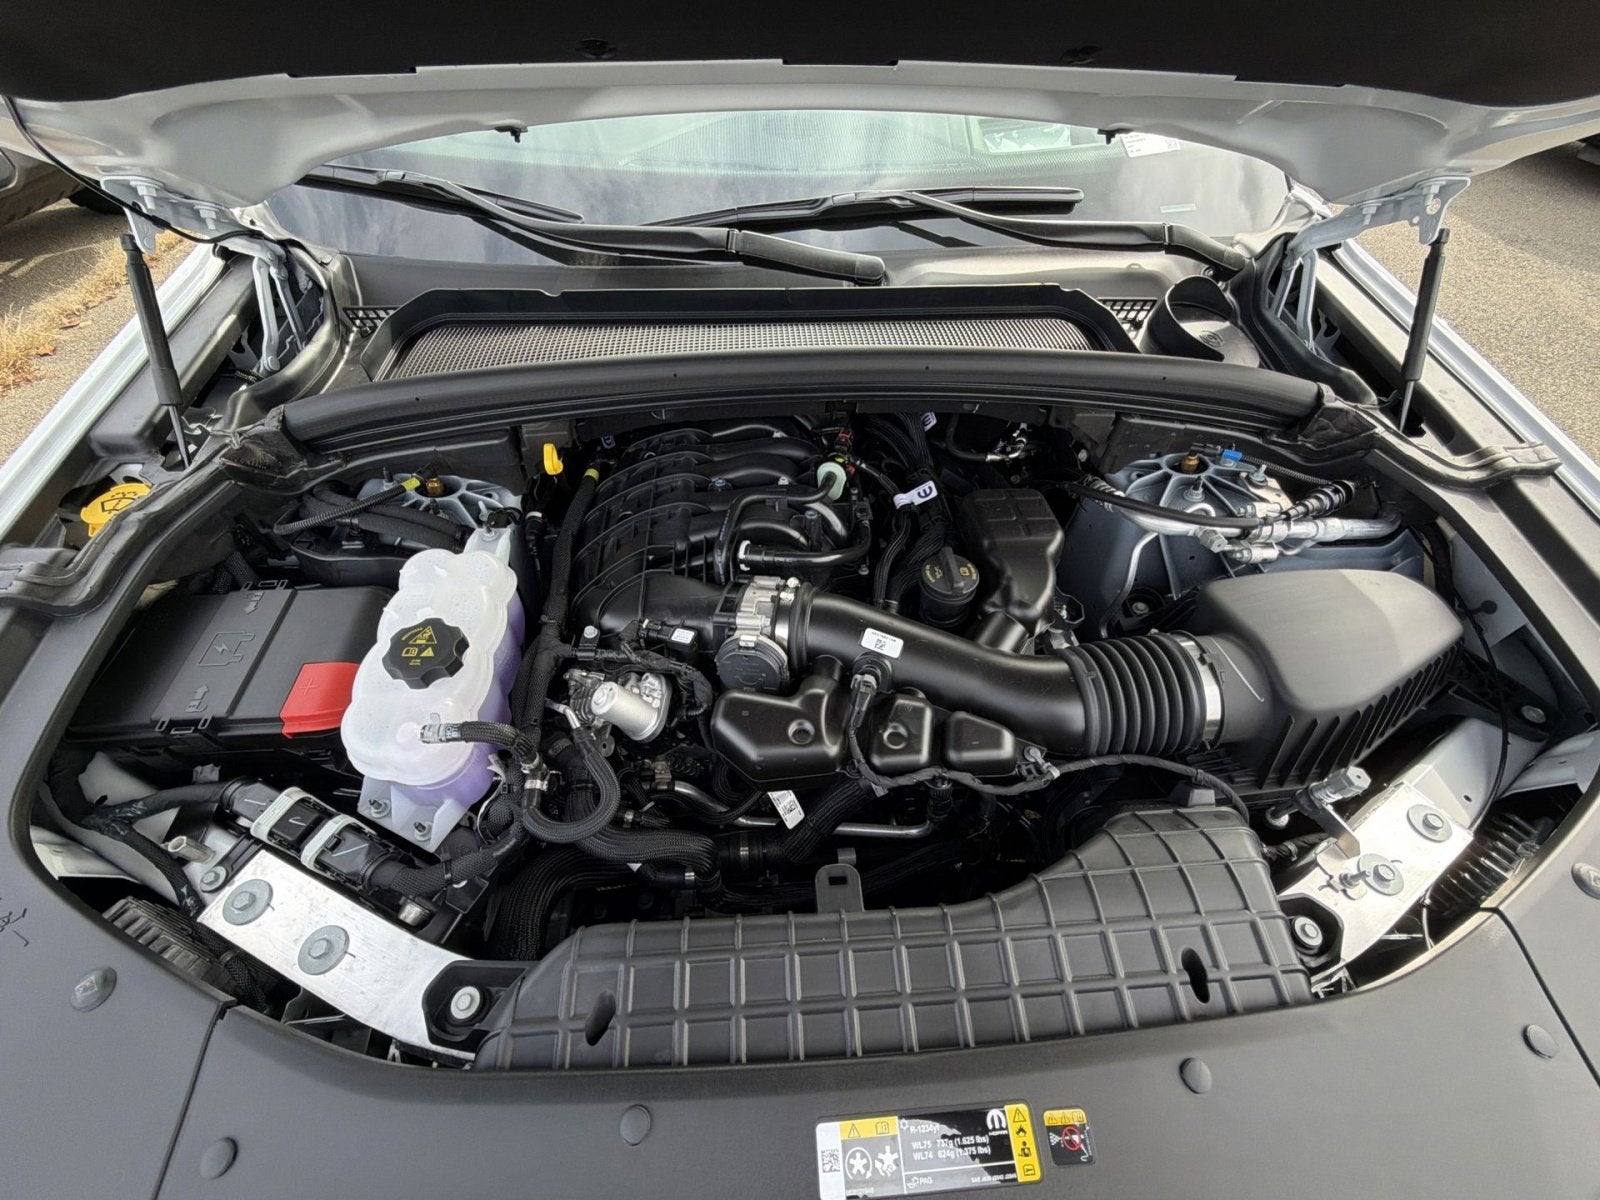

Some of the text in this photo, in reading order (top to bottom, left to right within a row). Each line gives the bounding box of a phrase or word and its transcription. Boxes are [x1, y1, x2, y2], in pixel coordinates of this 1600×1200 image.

[911, 1134, 989, 1150] WL75 737g (1.625 lbs)
[912, 1151, 933, 1161] WL74
[977, 1145, 991, 1155] lbs)
